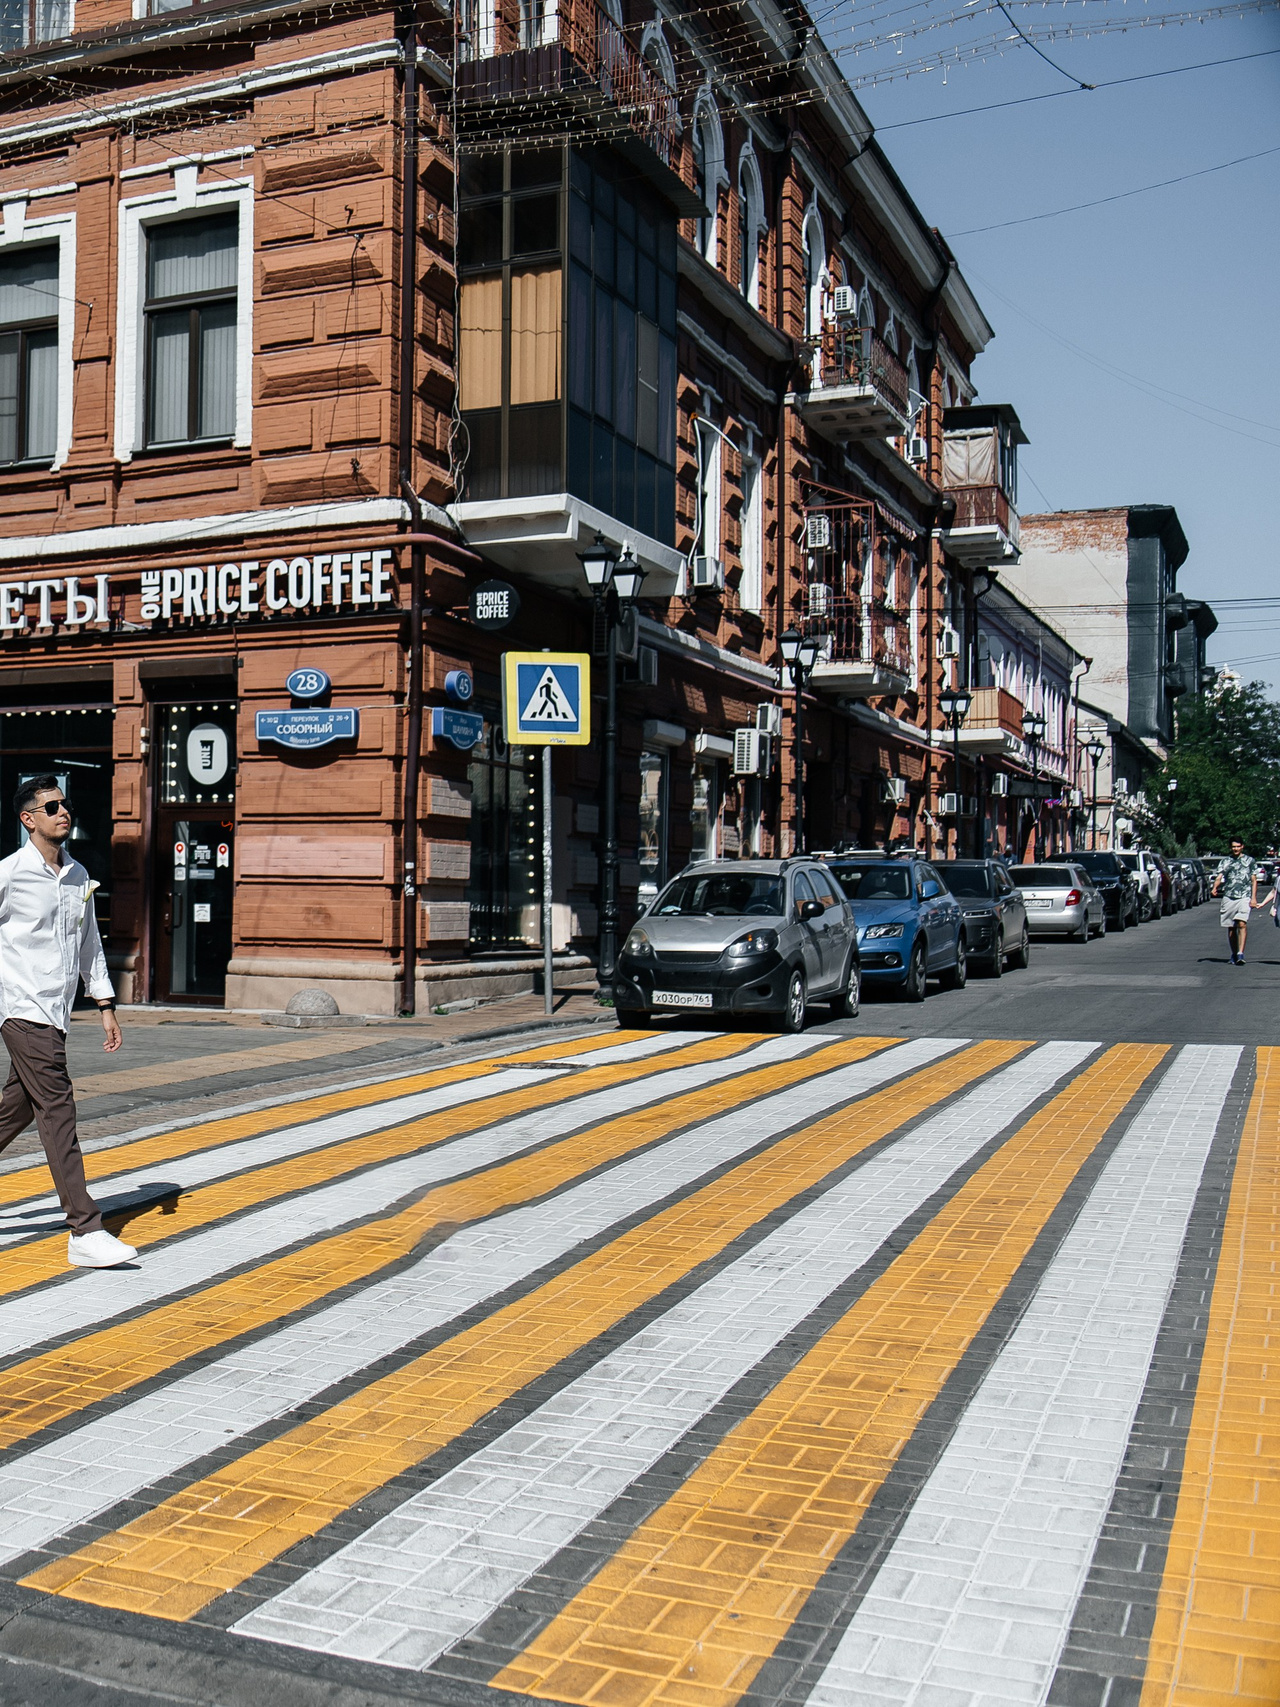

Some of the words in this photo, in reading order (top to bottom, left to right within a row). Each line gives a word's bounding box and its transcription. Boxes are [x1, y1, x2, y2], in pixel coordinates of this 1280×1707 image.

[141, 570, 160, 620] ONE
[162, 561, 259, 619] PRICE
[266, 550, 392, 610] COFFEE
[483, 591, 509, 606] PRICE
[476, 605, 509, 619] COFFEE
[296, 674, 318, 691] 28
[459, 678, 469, 694] 45
[291, 715, 320, 723] ПЕРЕУЛОК
[276, 722, 333, 735] СОБОРНЫЙ
[694, 994, 710, 1003] 761
